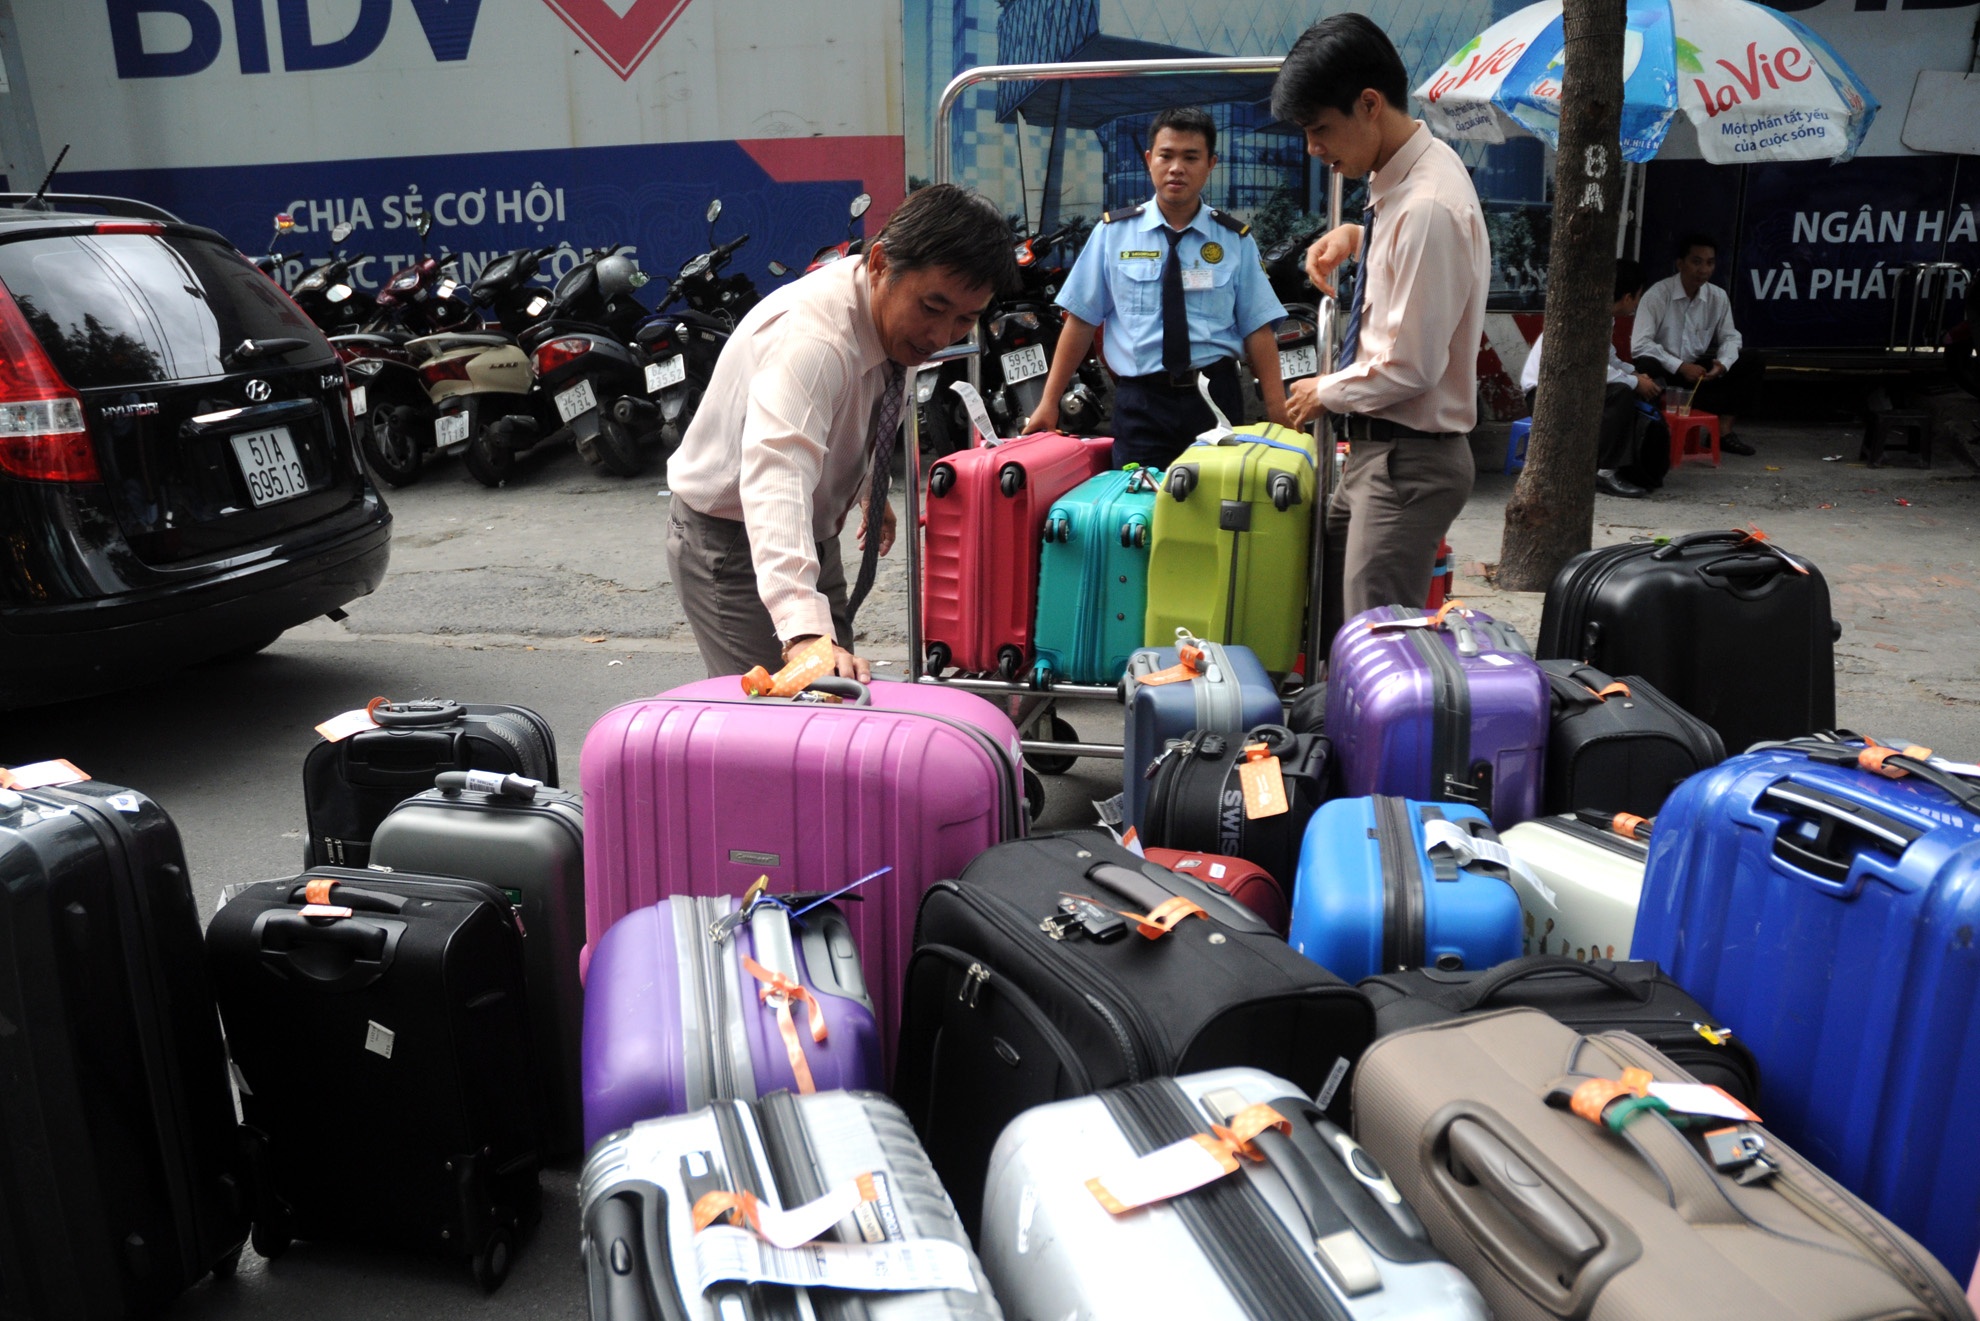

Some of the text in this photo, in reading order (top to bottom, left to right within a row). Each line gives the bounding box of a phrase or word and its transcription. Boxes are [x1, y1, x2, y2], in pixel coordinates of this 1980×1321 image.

[1722, 122, 1748, 138] Một
[1784, 109, 1803, 125] tất
[1805, 107, 1829, 122] yếu
[1735, 123, 1825, 152] của cuộc sống
[286, 197, 375, 233] CHIA
[434, 188, 486, 227] CƠ
[496, 181, 566, 233] HỘI
[1791, 203, 1908, 244] NGÂN
[1750, 261, 1799, 301] VÀ
[1808, 260, 1907, 300] PHÁT
[1008, 359, 1045, 381] 470.28
[1009, 348, 1037, 367] 59-E1
[101, 402, 160, 417] HYUNDAI
[247, 433, 287, 467] 51A
[248, 461, 307, 502] 695.13
